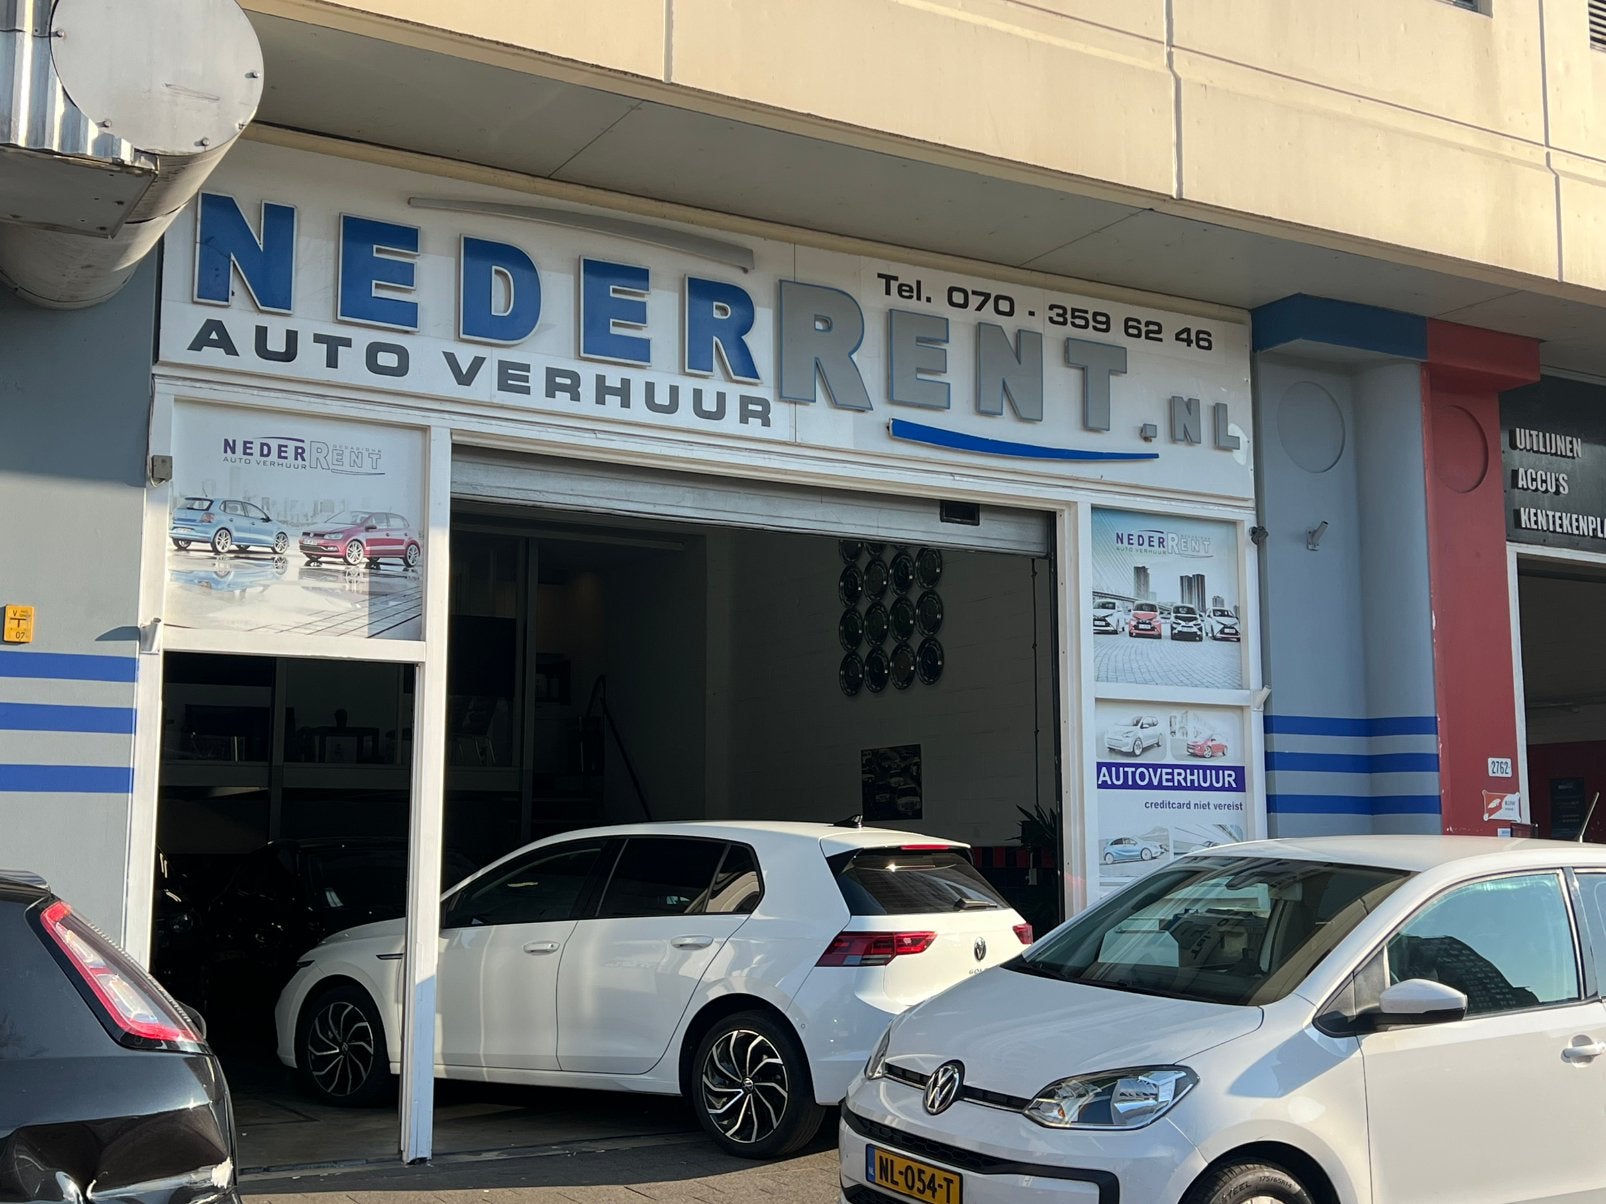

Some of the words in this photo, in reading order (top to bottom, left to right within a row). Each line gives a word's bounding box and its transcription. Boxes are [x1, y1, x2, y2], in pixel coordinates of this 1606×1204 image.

[877, 272, 932, 303] Tel.
[946, 286, 1016, 317] 070
[1047, 303, 1111, 334] 359
[1123, 316, 1164, 343] 62
[1174, 327, 1213, 351] 46
[187, 318, 411, 378] AUTO
[441, 350, 772, 428] VERHUUR
[1515, 427, 1582, 458] UITLIJNEN
[222, 456, 251, 465] AUTO
[255, 459, 308, 471] VERHUUR
[1517, 467, 1569, 495] ACCU'S
[1098, 766, 1237, 788] AUTOVERHUUR
[1490, 760, 1510, 775] 2762
[1144, 800, 1191, 810] creditcard
[1193, 800, 1211, 810] niet
[1213, 801, 1243, 811] vereist
[879, 1155, 955, 1204] NL-054-T
